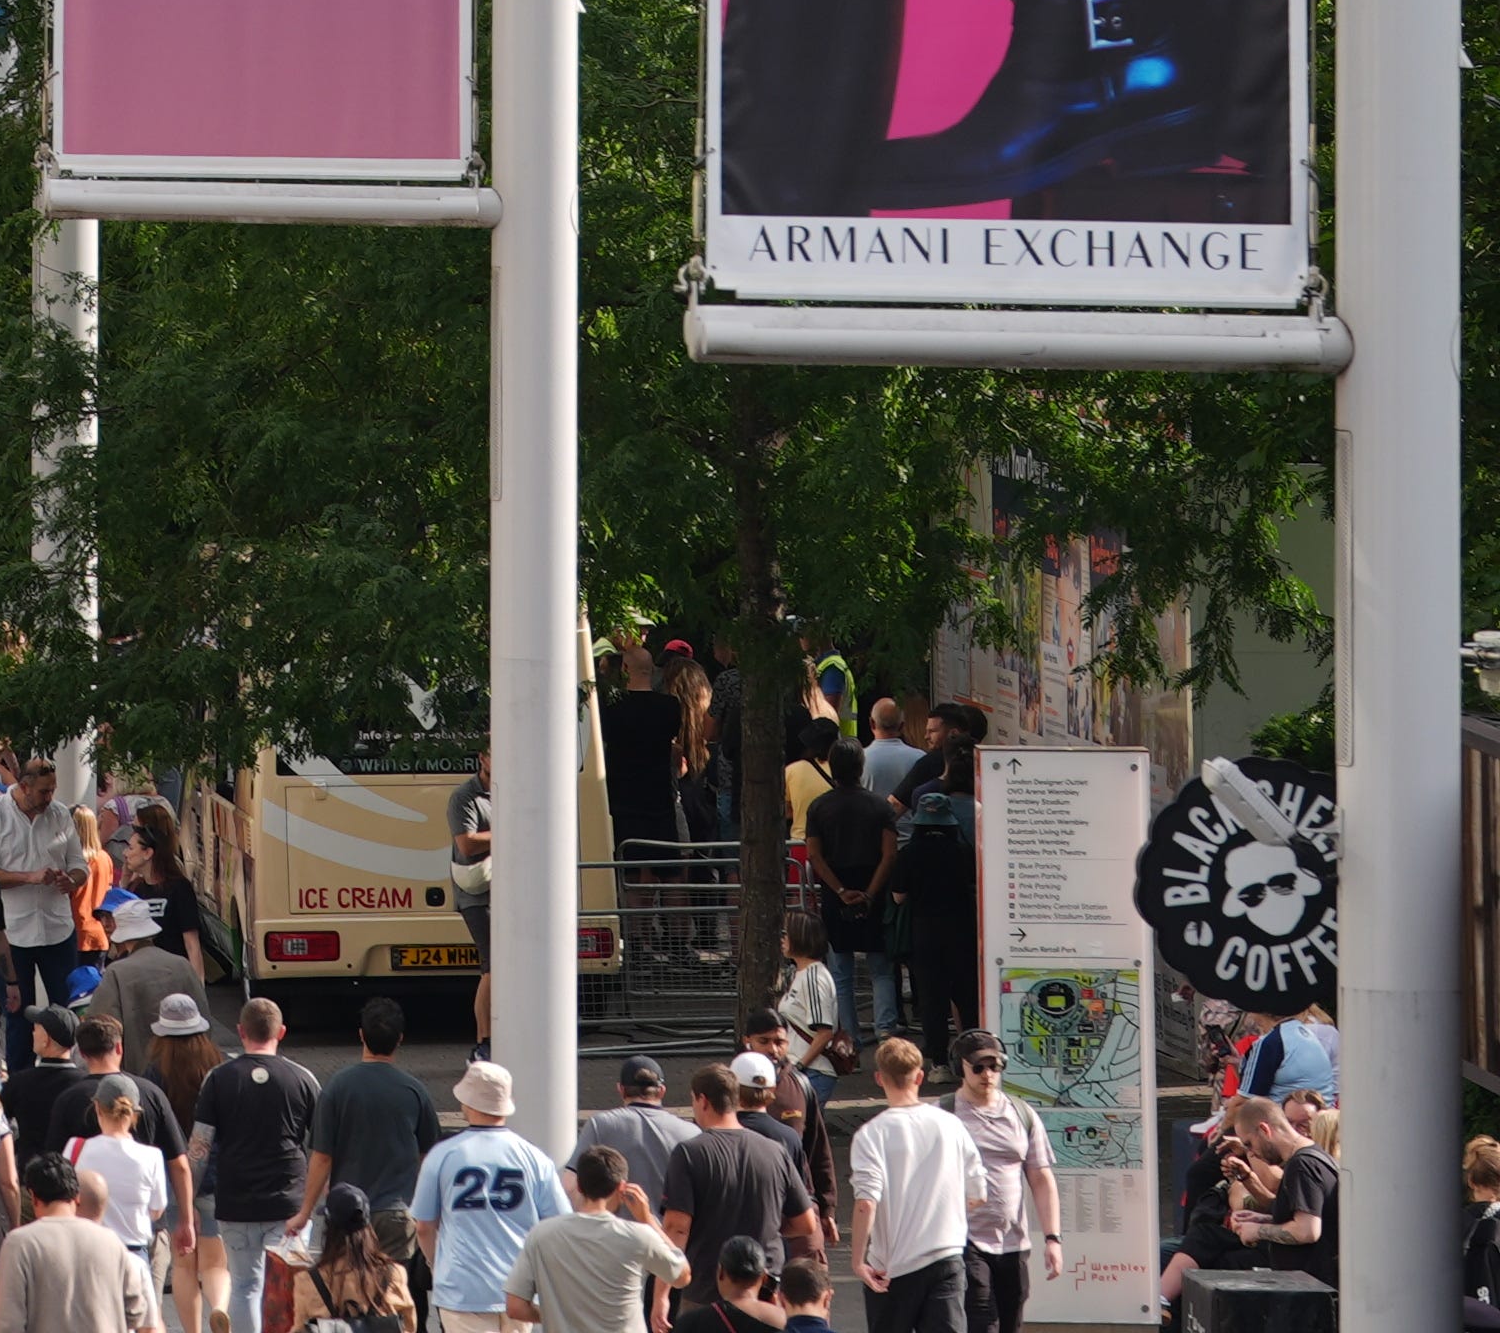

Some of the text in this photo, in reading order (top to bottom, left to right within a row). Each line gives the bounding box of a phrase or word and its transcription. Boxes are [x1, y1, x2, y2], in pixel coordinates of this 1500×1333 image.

[748, 224, 1264, 272] ARMANI EXCHANGE
[298, 887, 413, 910] ICE CREAM
[400, 949, 443, 965] FJ24
[451, 1166, 524, 1210] 25
[1090, 1262, 1146, 1274] Wembley
[1090, 1273, 1117, 1283] Park
